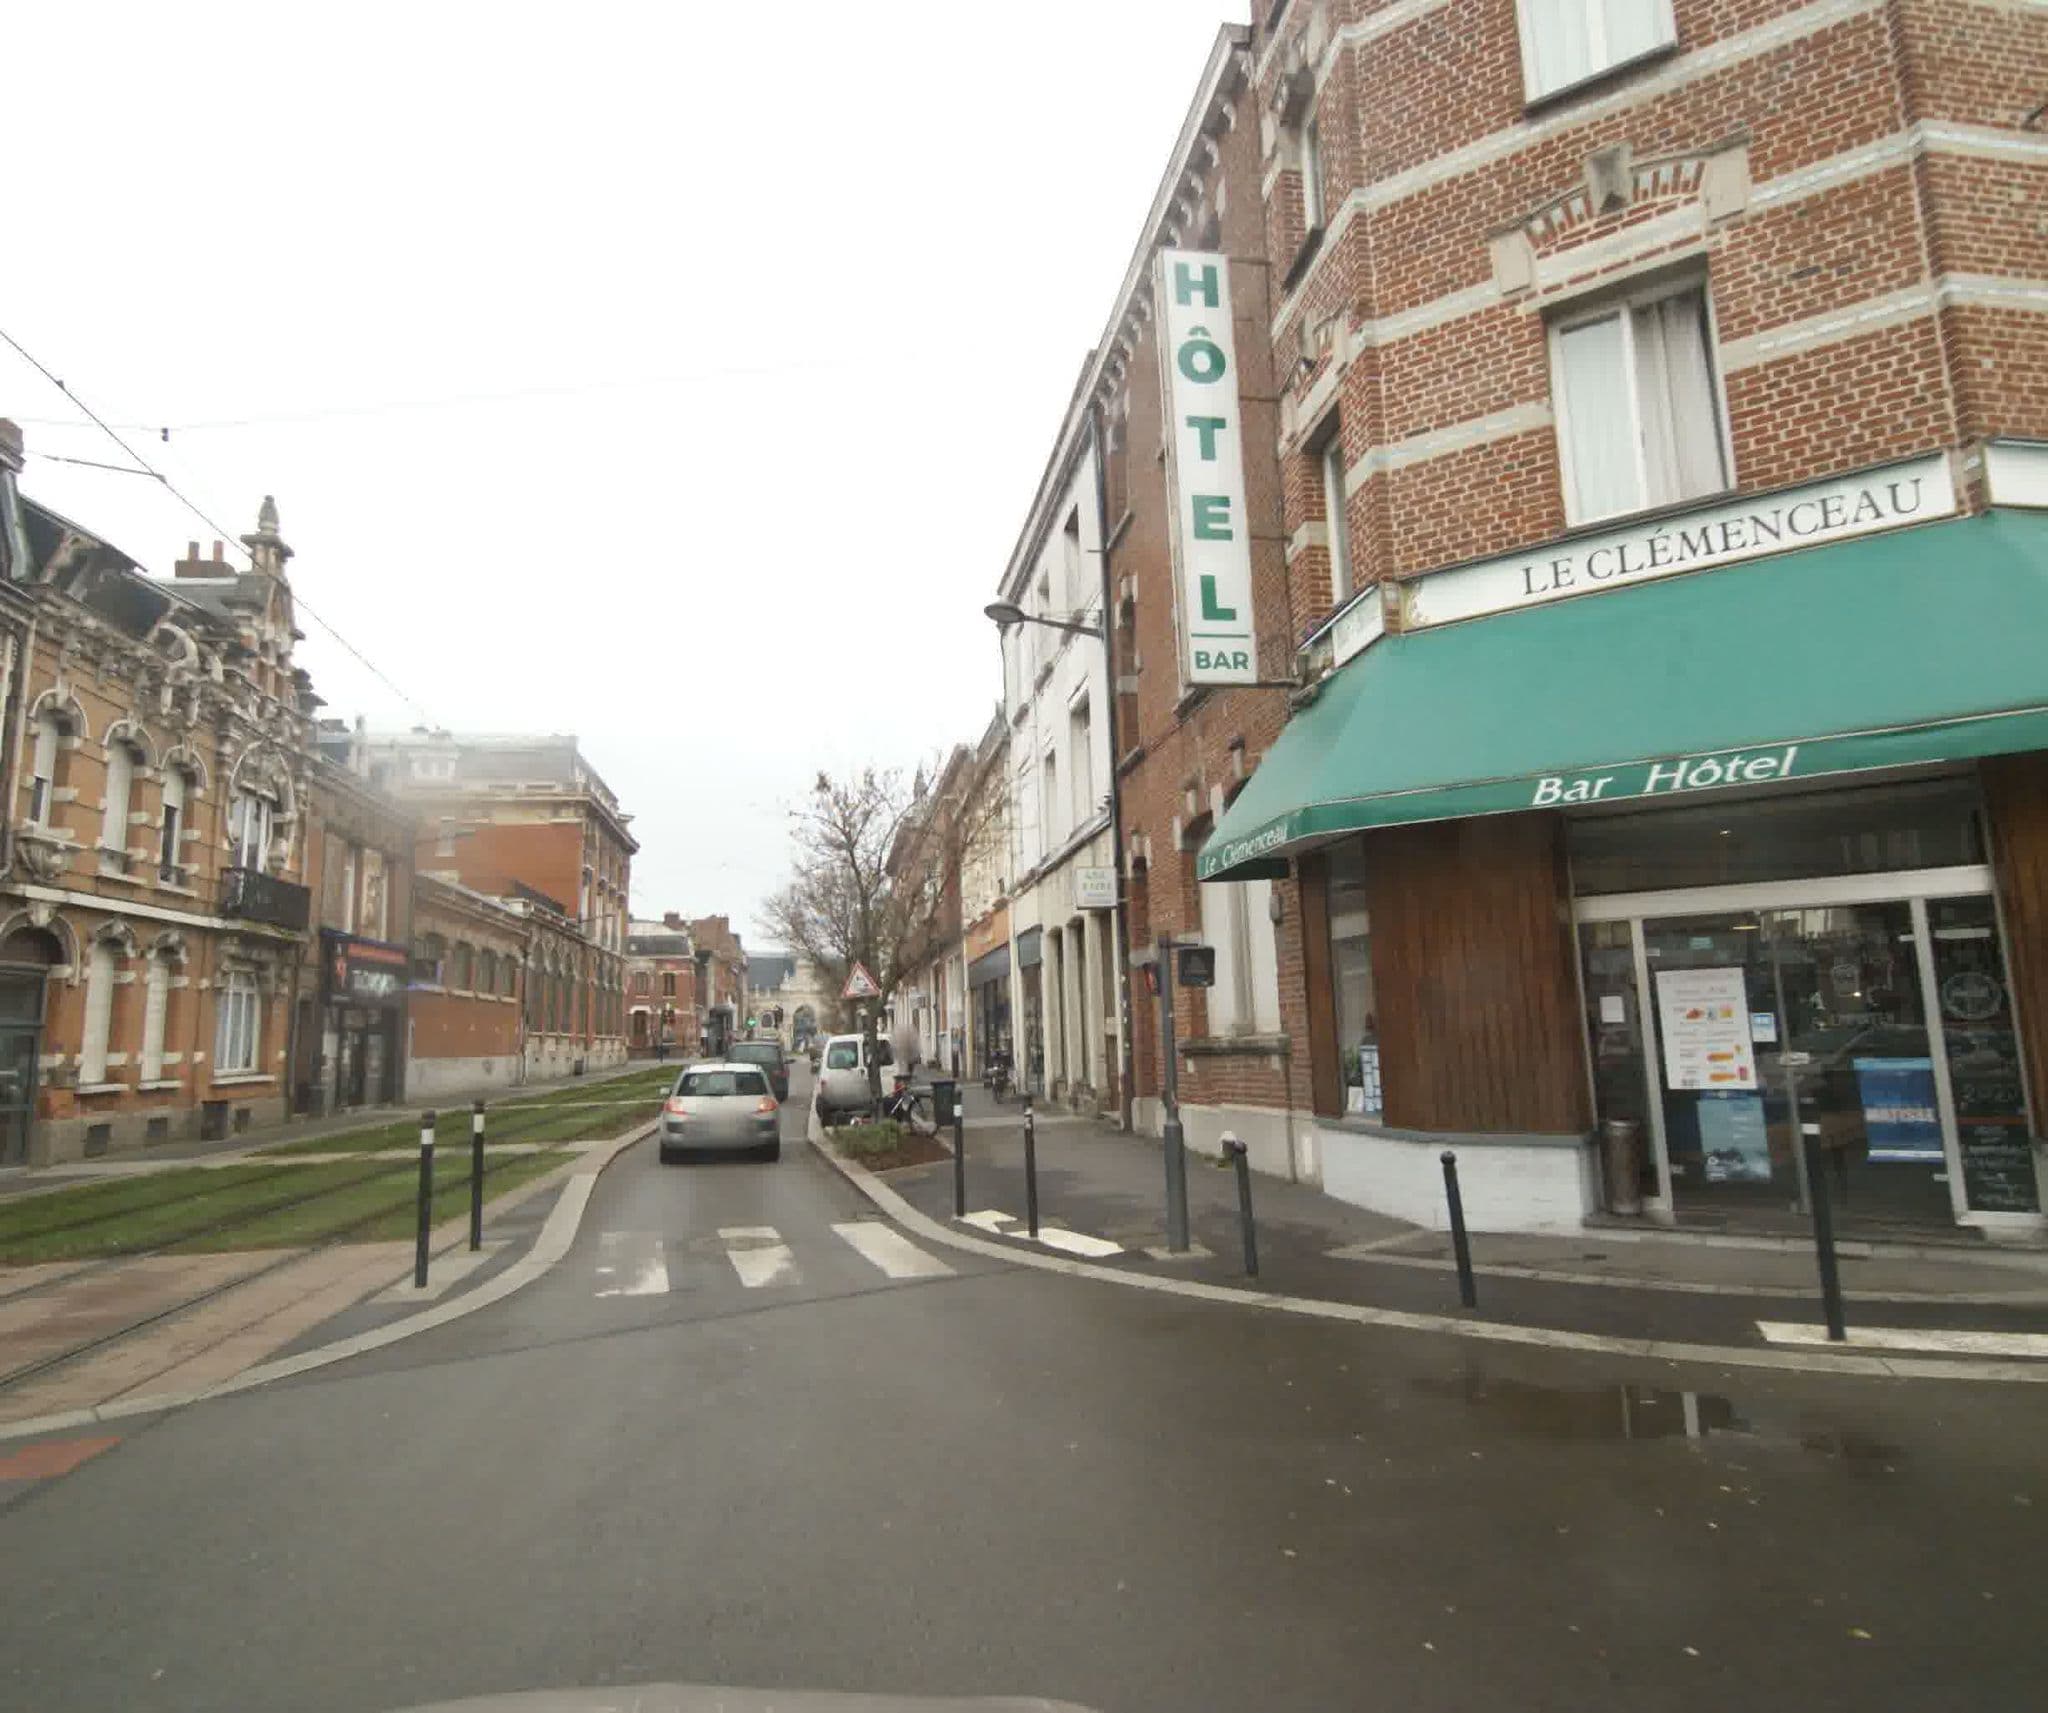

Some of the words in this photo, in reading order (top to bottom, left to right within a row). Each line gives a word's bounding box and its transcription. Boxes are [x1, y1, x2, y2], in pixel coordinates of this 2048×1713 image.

[1174, 263, 1237, 621] HÔTEL
[1521, 558, 1575, 596] LE
[1587, 477, 1925, 580] CLÉMENCEAU
[1195, 650, 1249, 670] BAR
[1532, 776, 1614, 806] Bar
[1643, 746, 1798, 794] Hôtel
